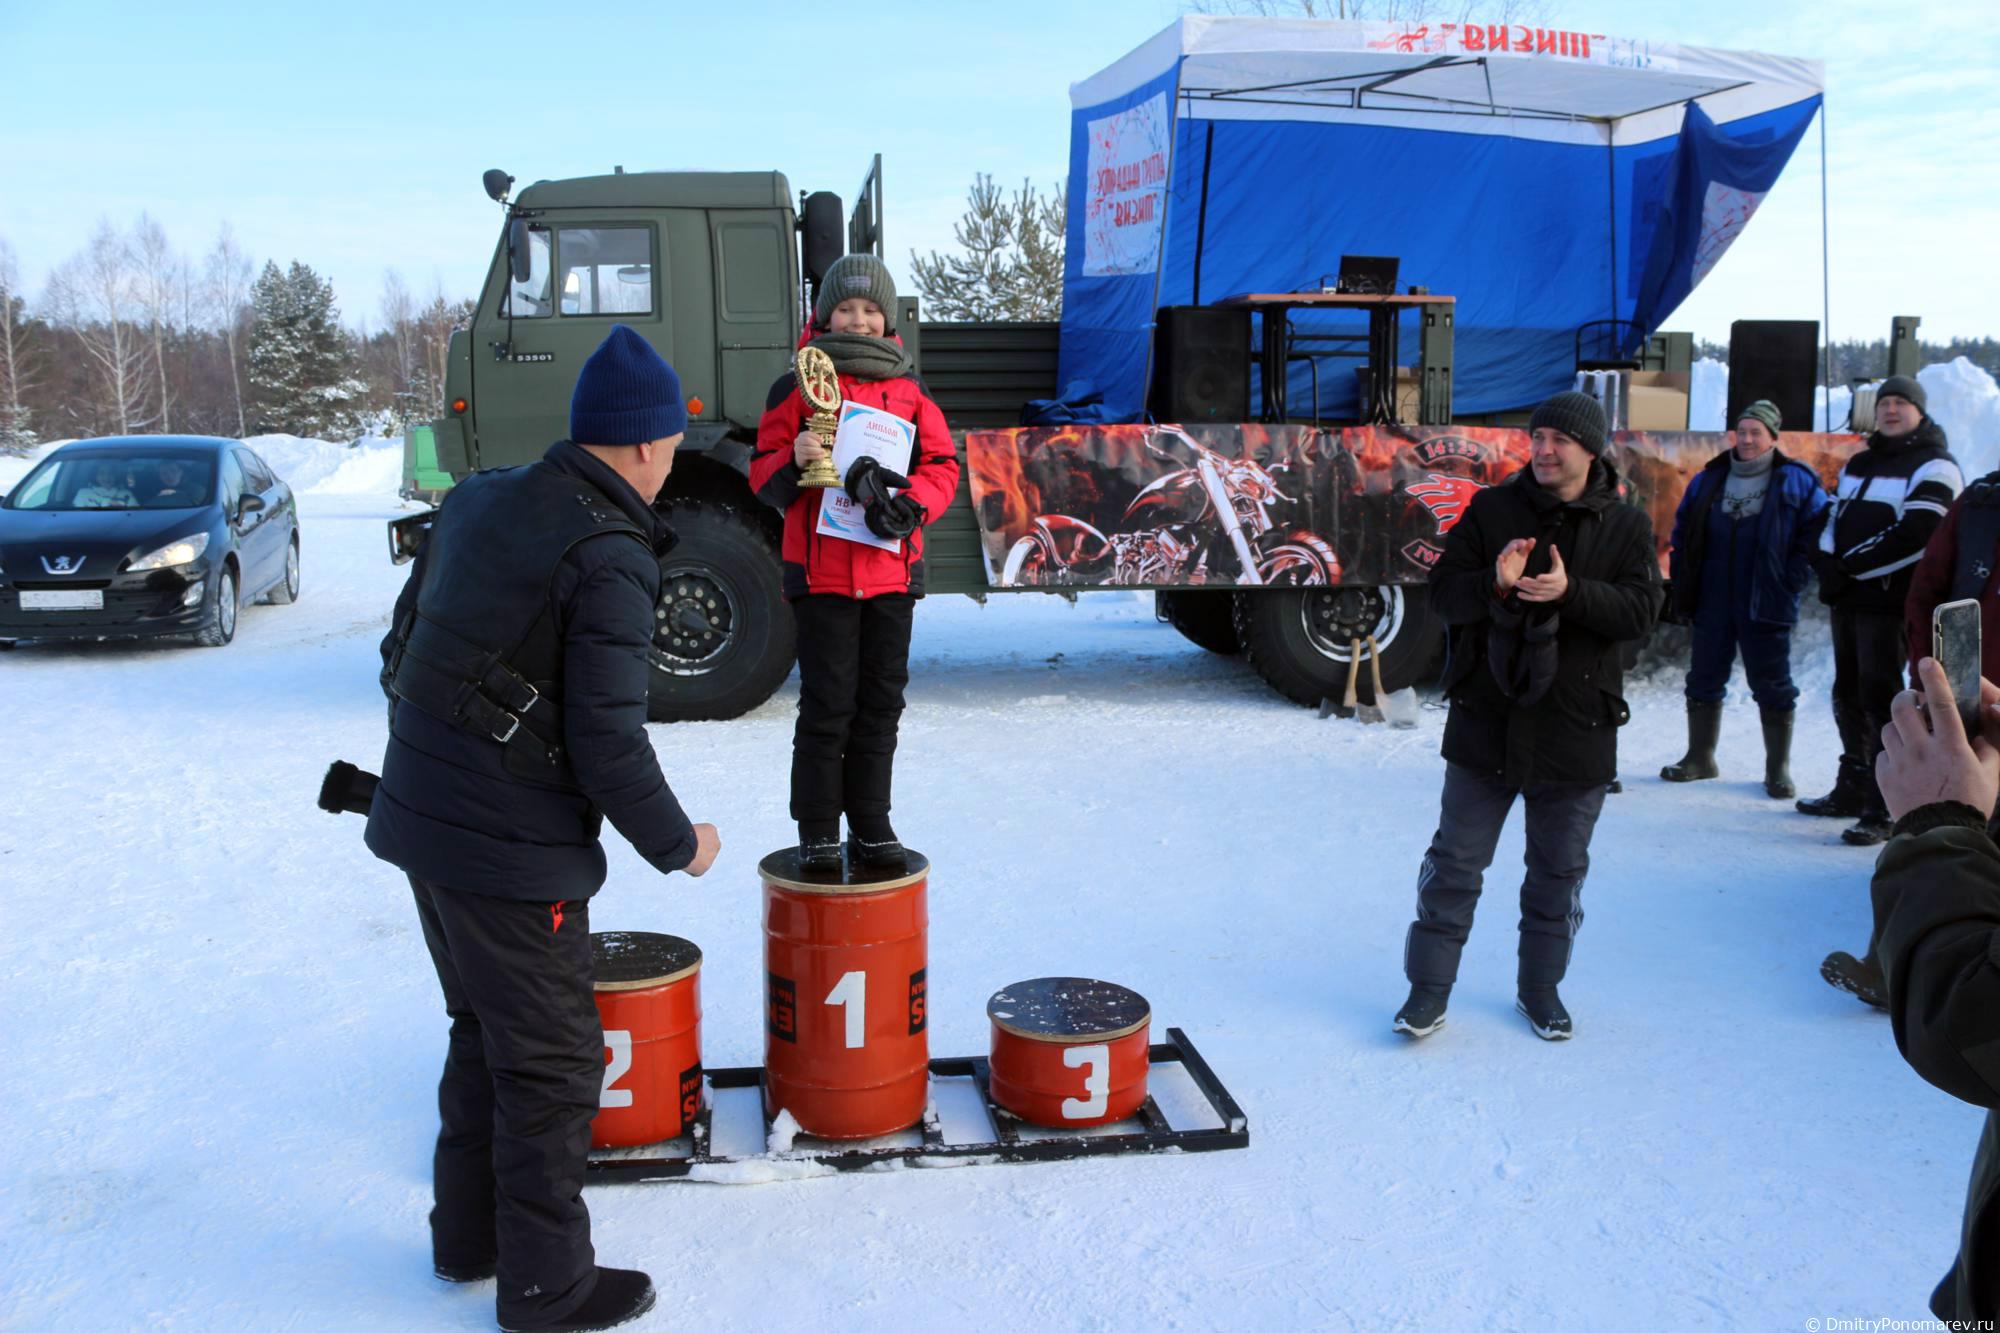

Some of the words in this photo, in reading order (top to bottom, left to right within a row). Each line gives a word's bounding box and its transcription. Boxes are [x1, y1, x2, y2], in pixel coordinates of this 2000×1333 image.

[866, 420, 899, 438] ДИПЛОМ
[824, 970, 867, 1049] 1
[599, 1029, 633, 1109] 2
[1061, 1045, 1110, 1119] 3
